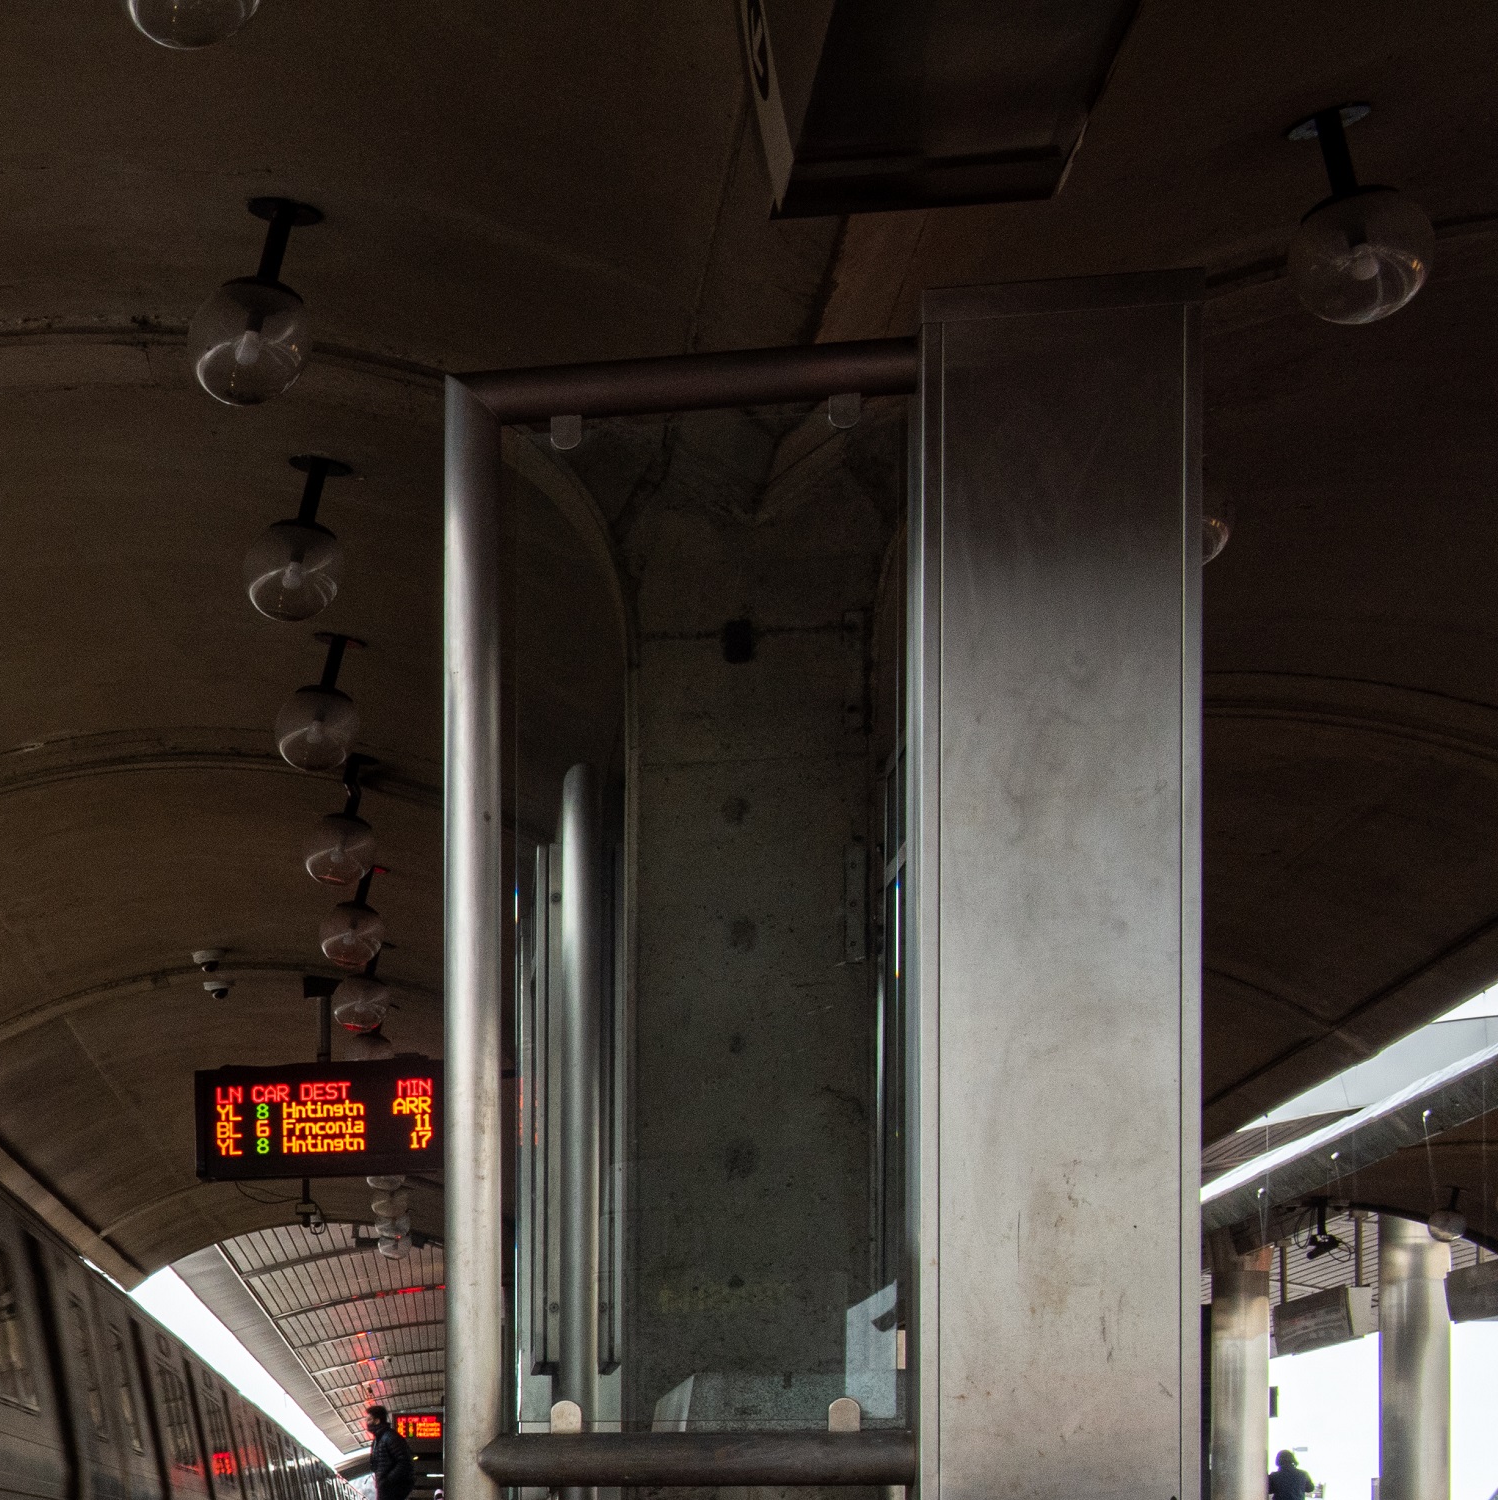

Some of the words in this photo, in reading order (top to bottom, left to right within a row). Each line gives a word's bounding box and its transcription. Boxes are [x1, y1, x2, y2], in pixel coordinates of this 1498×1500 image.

[216, 1086, 243, 1103] LN
[251, 1083, 290, 1103] CAR
[300, 1081, 351, 1101] DEST
[397, 1078, 433, 1097] MIN
[216, 1105, 242, 1121] YL
[256, 1103, 270, 1120] 8
[392, 1096, 432, 1115] ARR
[216, 1122, 242, 1138] BL
[255, 1119, 271, 1138] 6
[282, 1117, 365, 1136] Frnconia
[414, 1114, 432, 1131] 11
[216, 1138, 243, 1156] YL
[256, 1138, 270, 1154] 8
[410, 1131, 432, 1149] 17
